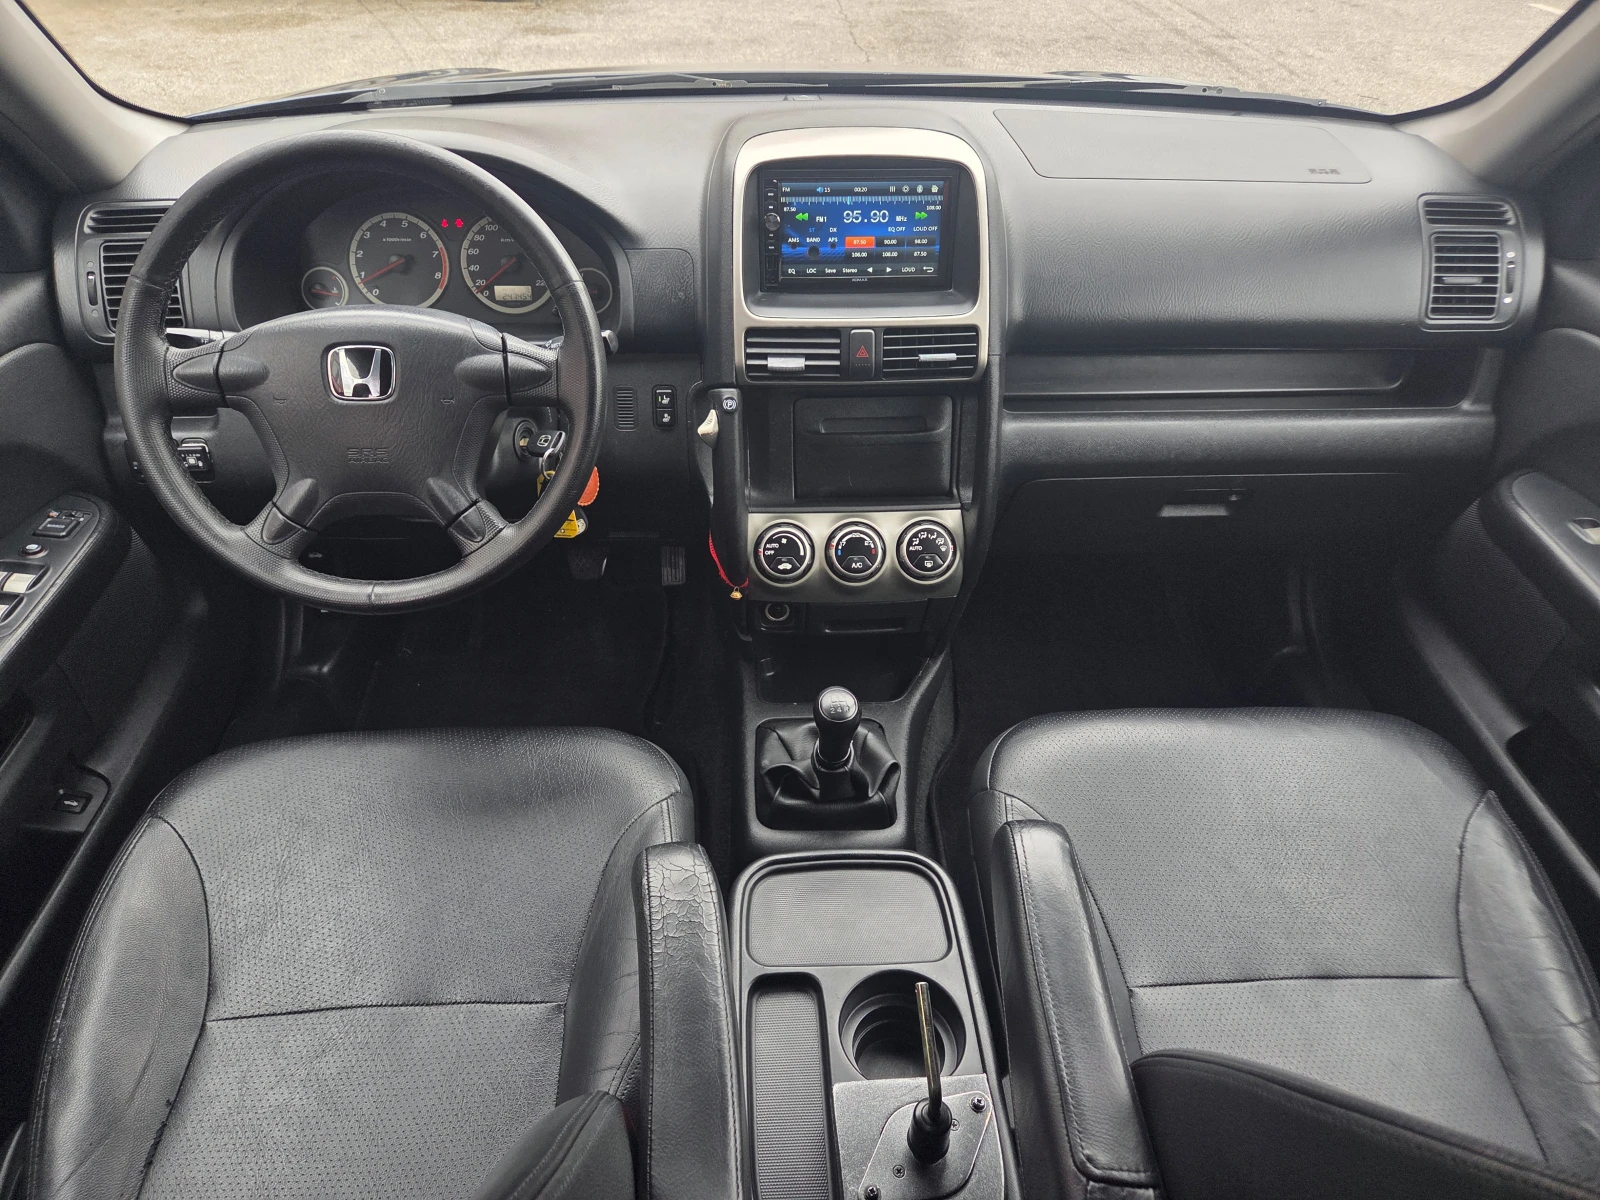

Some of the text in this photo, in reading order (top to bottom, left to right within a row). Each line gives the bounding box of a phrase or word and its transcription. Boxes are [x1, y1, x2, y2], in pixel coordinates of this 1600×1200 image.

[843, 210, 889, 223] 95.90
[485, 224, 499, 232] 100
[359, 271, 366, 279] 1
[434, 272, 442, 280] 8
